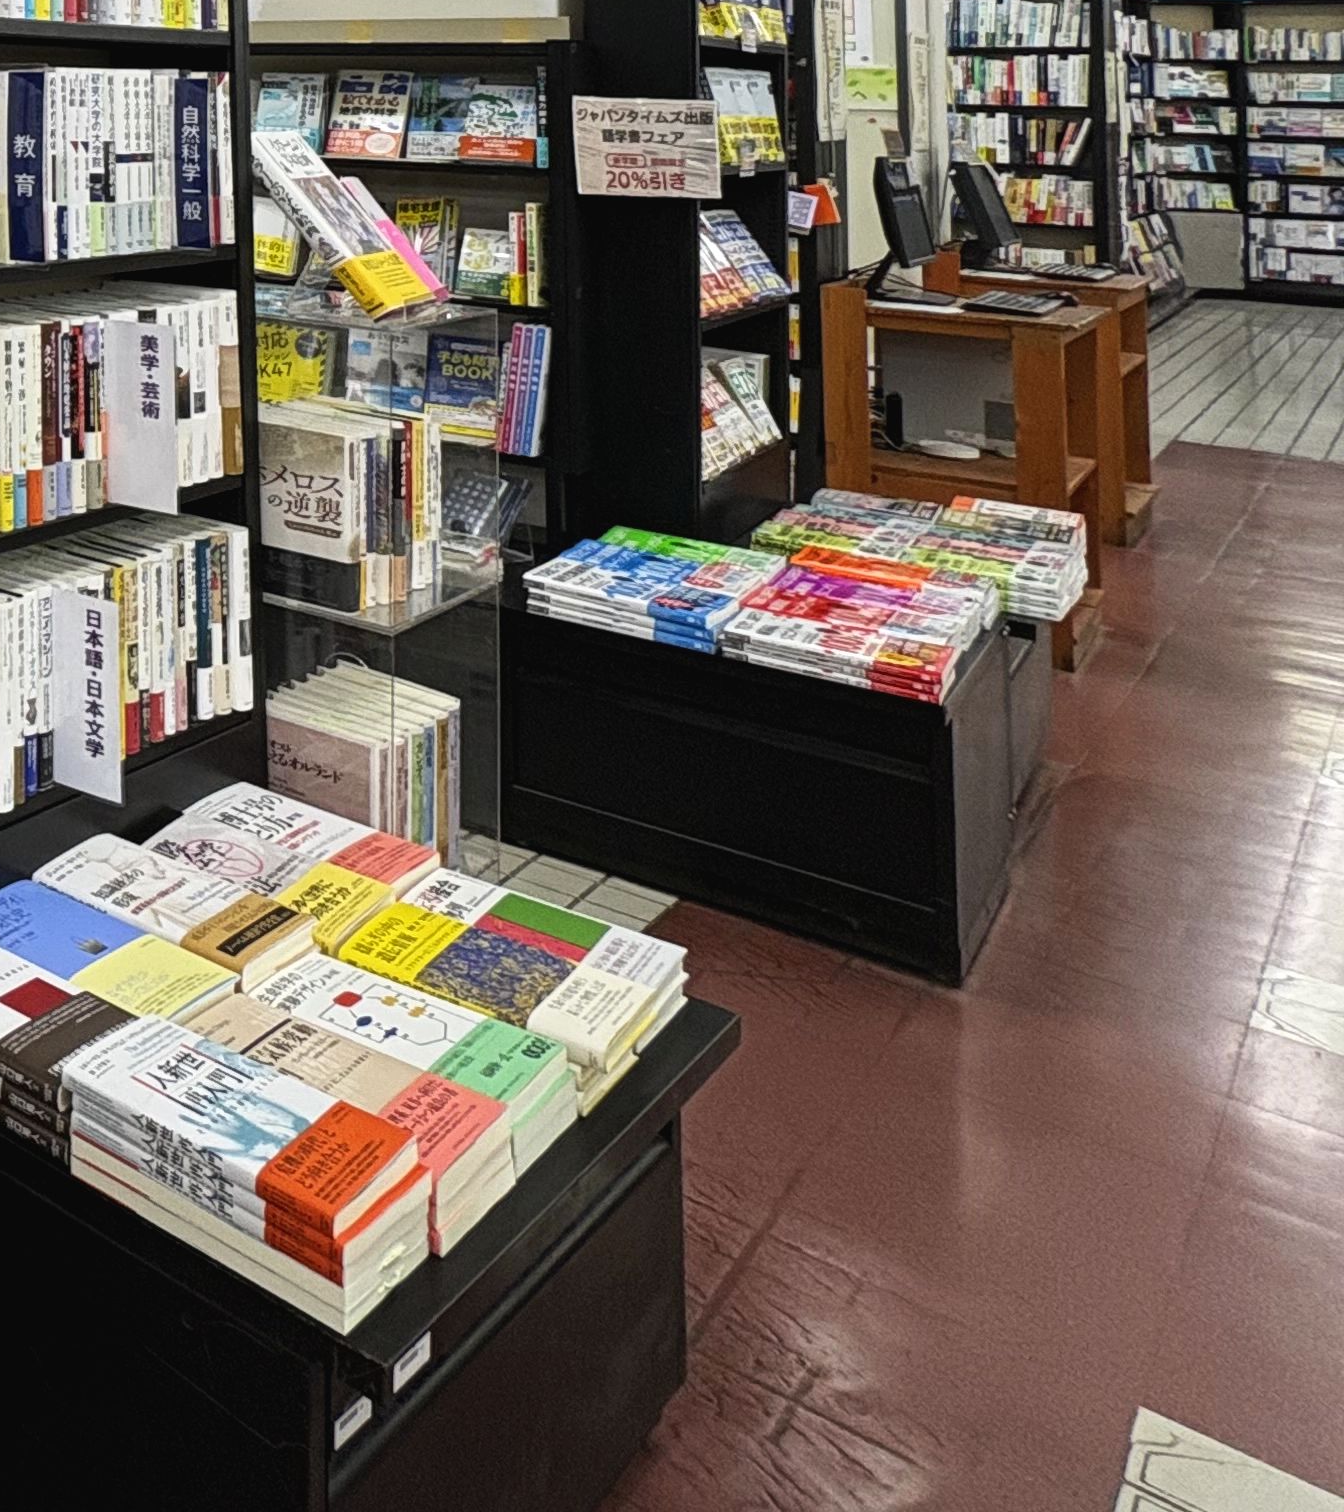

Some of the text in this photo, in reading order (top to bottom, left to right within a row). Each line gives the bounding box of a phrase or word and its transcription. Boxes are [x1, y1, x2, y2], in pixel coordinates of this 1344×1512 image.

[576, 109, 713, 125] ジャパンタイムズ出版
[13, 134, 36, 198] 教育
[181, 105, 202, 222] 自然科学一般
[606, 171, 686, 190] 20%引き
[140, 335, 160, 419] 美学・芸術
[84, 609, 104, 758] 日本語・日本文学
